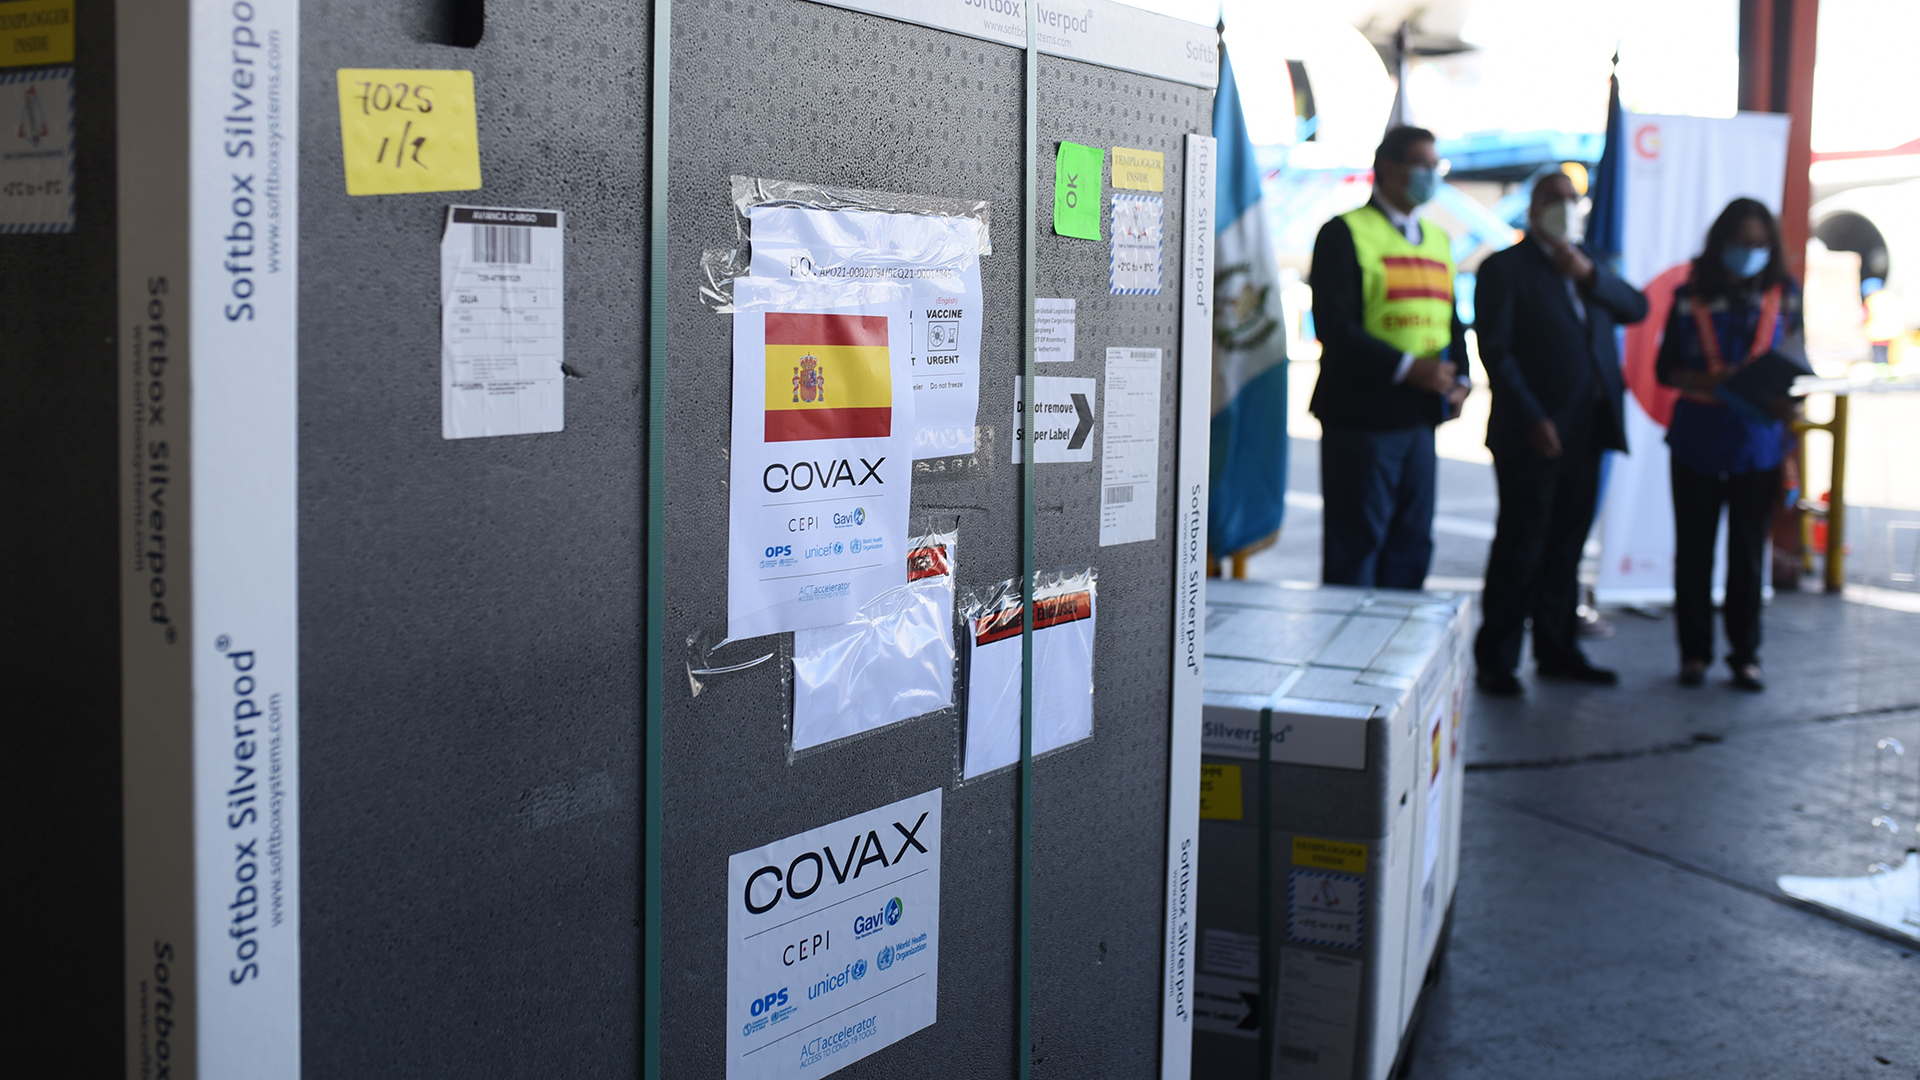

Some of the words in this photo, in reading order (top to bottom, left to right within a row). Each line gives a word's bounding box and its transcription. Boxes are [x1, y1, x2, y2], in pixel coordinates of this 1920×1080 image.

[964, 0, 1021, 18] oftbox
[1036, 2, 1093, 34] lverpod®
[1186, 41, 1216, 63] Softb
[354, 82, 433, 115] 7025
[263, 29, 285, 274] www.softboxsystems.com
[1114, 154, 1162, 170] TEMPLOGGER
[1066, 173, 1078, 209] OK
[1127, 172, 1149, 183] INSIDE
[508, 212, 538, 223] CARGO
[224, 173, 255, 322] Softbox
[926, 309, 963, 319] VACCINE
[147, 276, 169, 427] Softbox
[926, 355, 960, 365] URGENT
[930, 382, 938, 390] Do
[948, 381, 963, 389] freeze
[1034, 402, 1043, 413] ot
[1044, 404, 1073, 414] remove
[1049, 428, 1070, 440] Label
[762, 457, 886, 493] COVAX
[788, 516, 819, 532] CEPI
[833, 512, 853, 525] Gavi
[1190, 484, 1201, 565] Softbox
[765, 545, 792, 558] OPS
[805, 542, 832, 558] unicef
[798, 582, 851, 597] ACTaccelerator
[1037, 600, 1078, 621] ENCLOSED
[266, 692, 286, 929] www.softboxsystems.com
[744, 811, 930, 914] COVAX
[1179, 838, 1191, 918] Softbox
[228, 838, 260, 986] Softbox
[854, 908, 884, 935] Gavi
[783, 930, 830, 966] CEPI
[896, 937, 911, 951] World
[911, 932, 927, 945] Health
[896, 943, 927, 961] Organization
[808, 964, 850, 1000] unicef
[154, 938, 175, 1080] Softbox
[750, 987, 788, 1017] OPS
[800, 1015, 877, 1061] ACTaccelerator
[800, 1052, 822, 1069] ACCESS
[823, 1048, 831, 1058] TO
[831, 1035, 858, 1054] COVID-19
[858, 1026, 877, 1040] TOOLS
